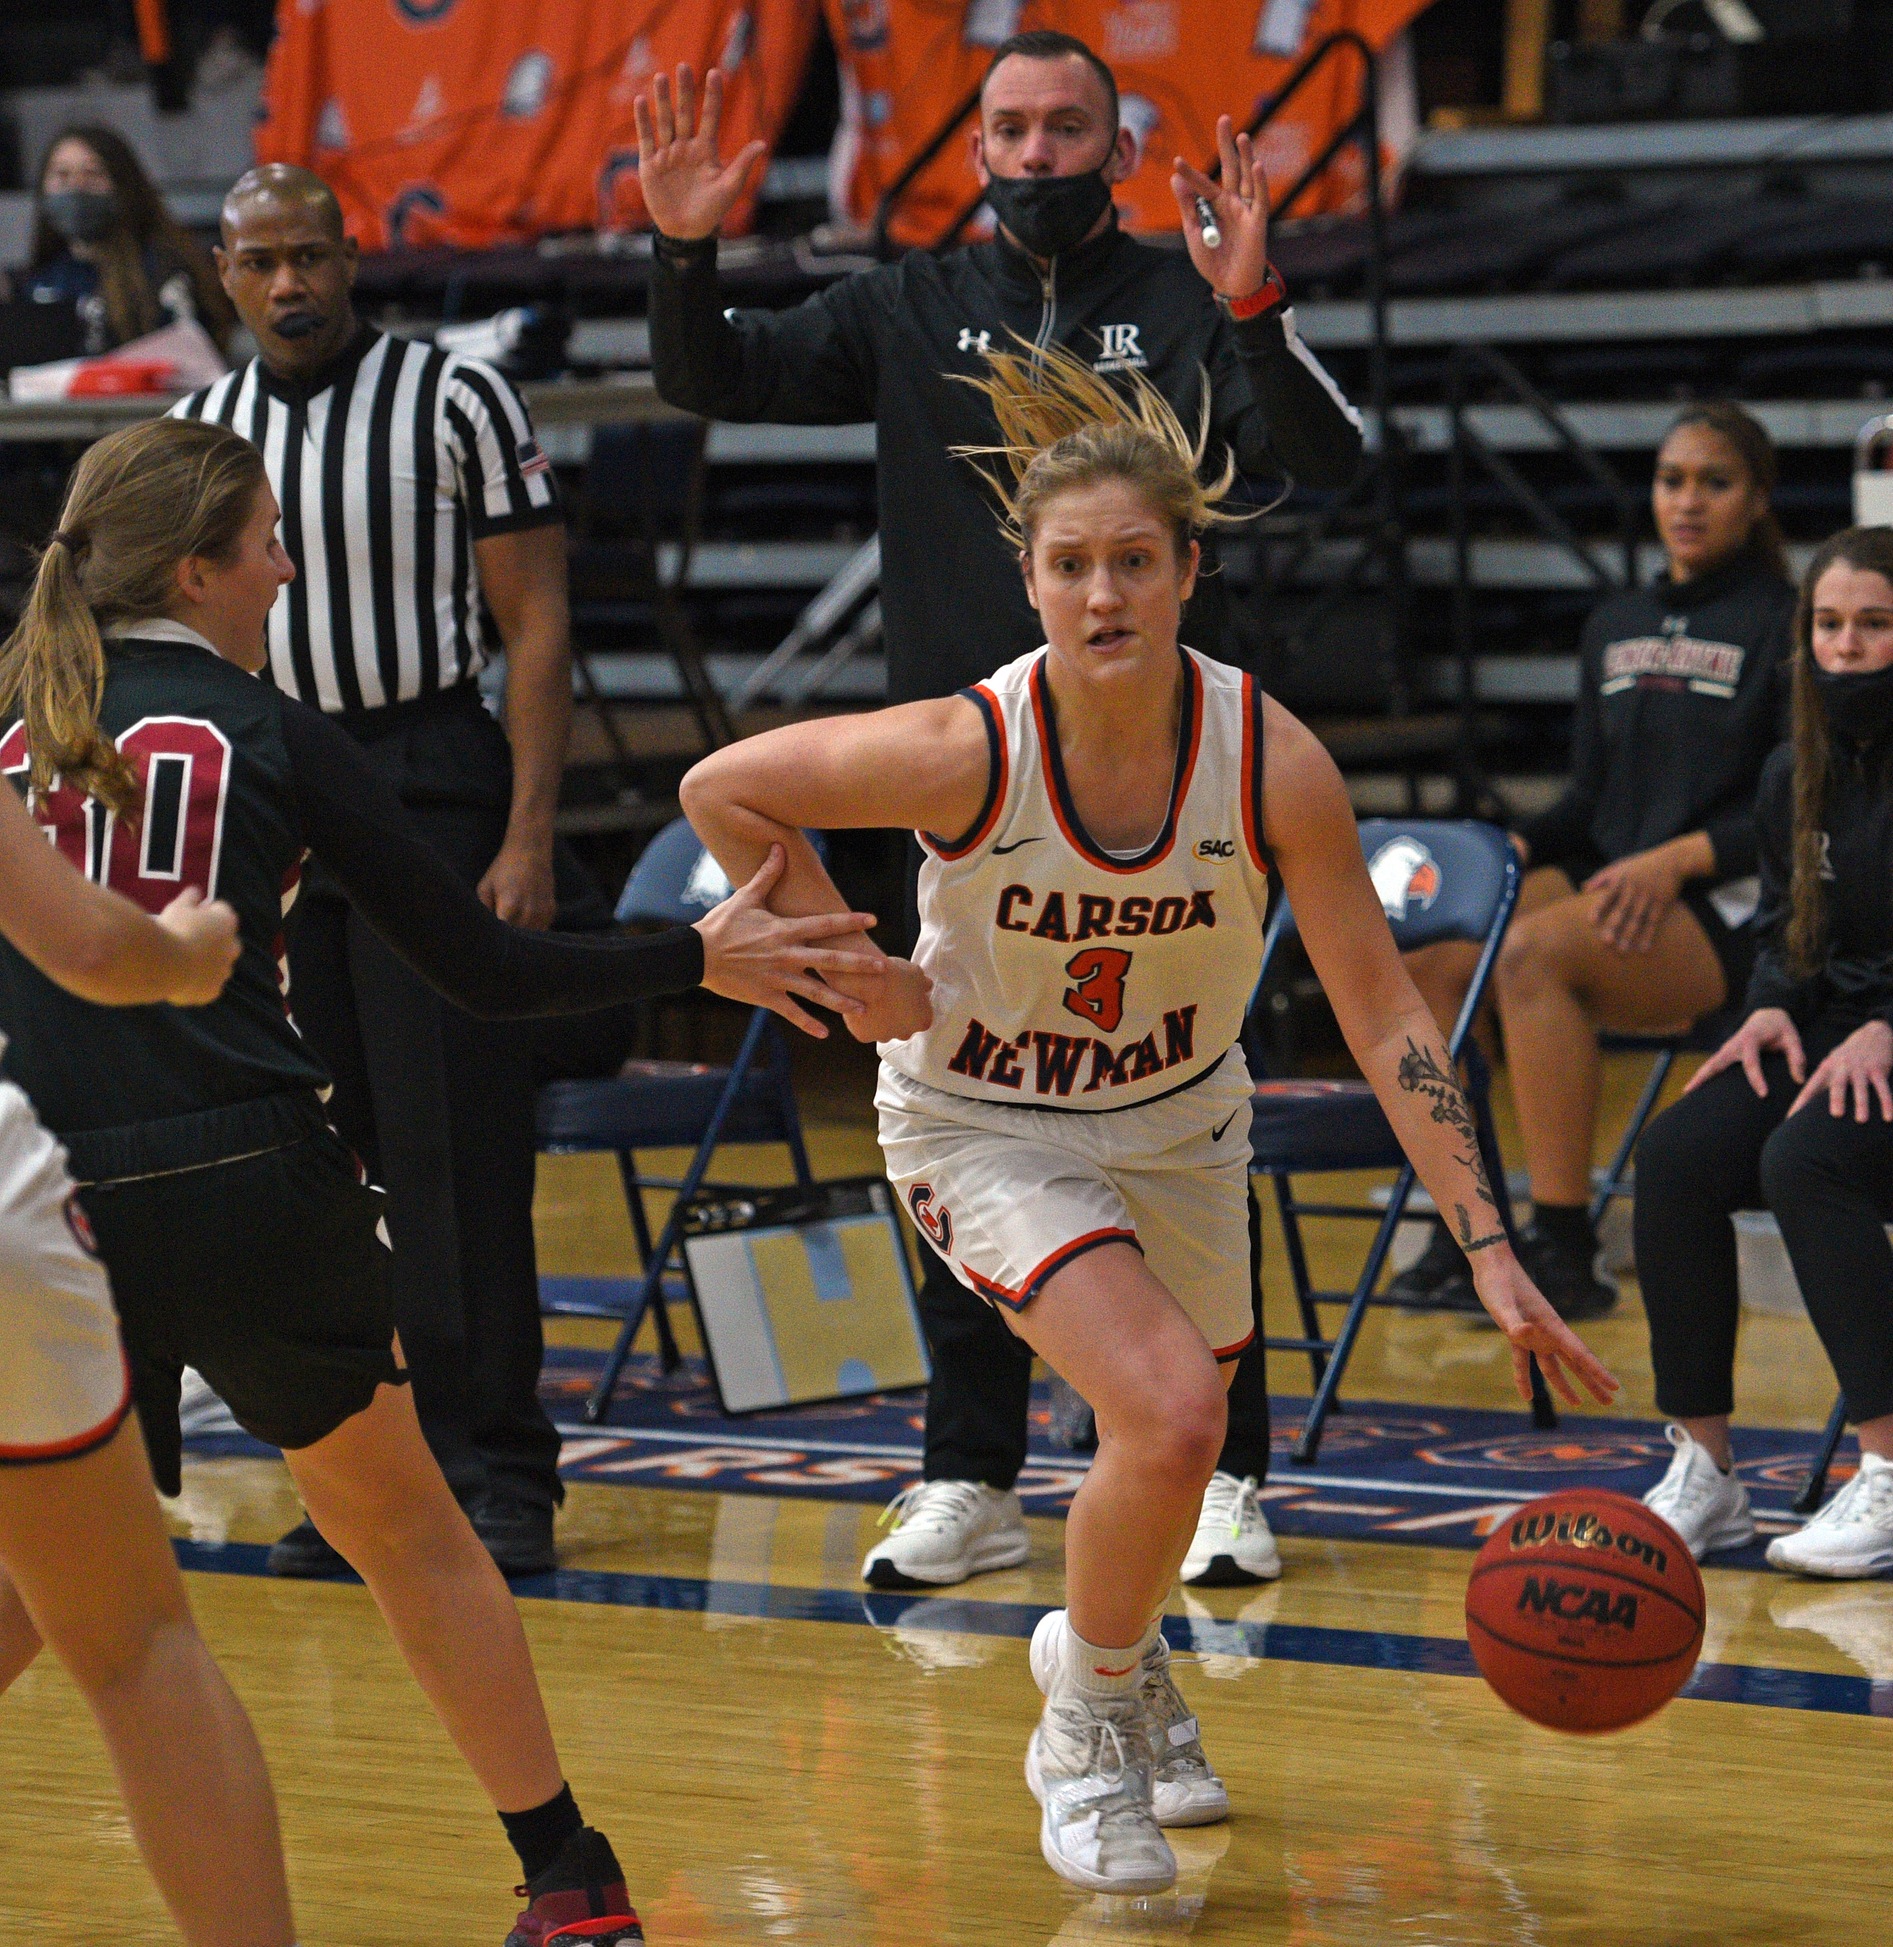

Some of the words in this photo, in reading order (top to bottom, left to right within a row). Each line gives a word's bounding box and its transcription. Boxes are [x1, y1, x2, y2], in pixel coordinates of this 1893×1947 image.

[1199, 840, 1235, 857] SAC
[1063, 947, 1134, 1034] 3
[947, 1004, 1198, 1097] NEWMAN
[1510, 1511, 1668, 1575] Wilson
[1517, 1575, 1637, 1632] NCAA
